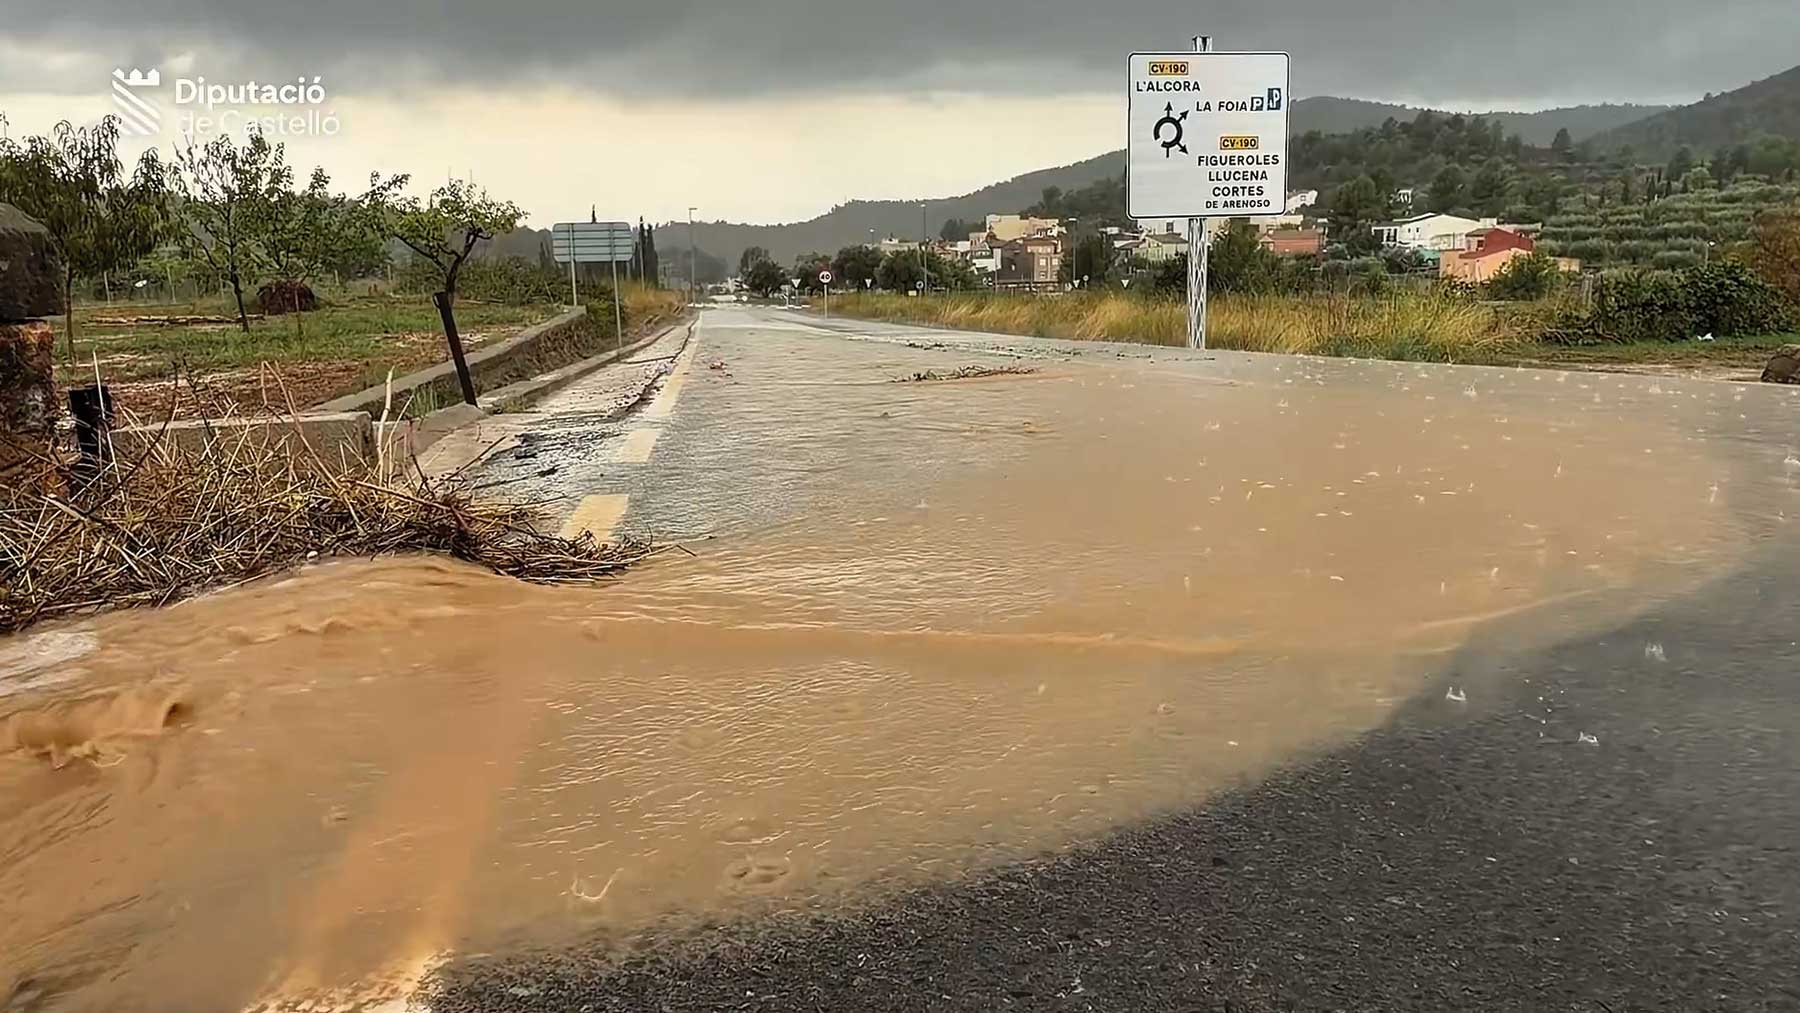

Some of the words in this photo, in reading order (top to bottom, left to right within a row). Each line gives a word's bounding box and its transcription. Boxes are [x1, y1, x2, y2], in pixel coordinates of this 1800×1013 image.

[1136, 80, 1201, 92] L'ALCORA
[1196, 101, 1212, 112] LA
[1218, 100, 1248, 112] FOIA
[1197, 154, 1280, 167] FIGUEROLES
[1208, 170, 1268, 182] LLUCENA
[1212, 186, 1264, 197] CORTES
[1205, 200, 1219, 209] DE
[1222, 199, 1271, 209] ARENOSO
